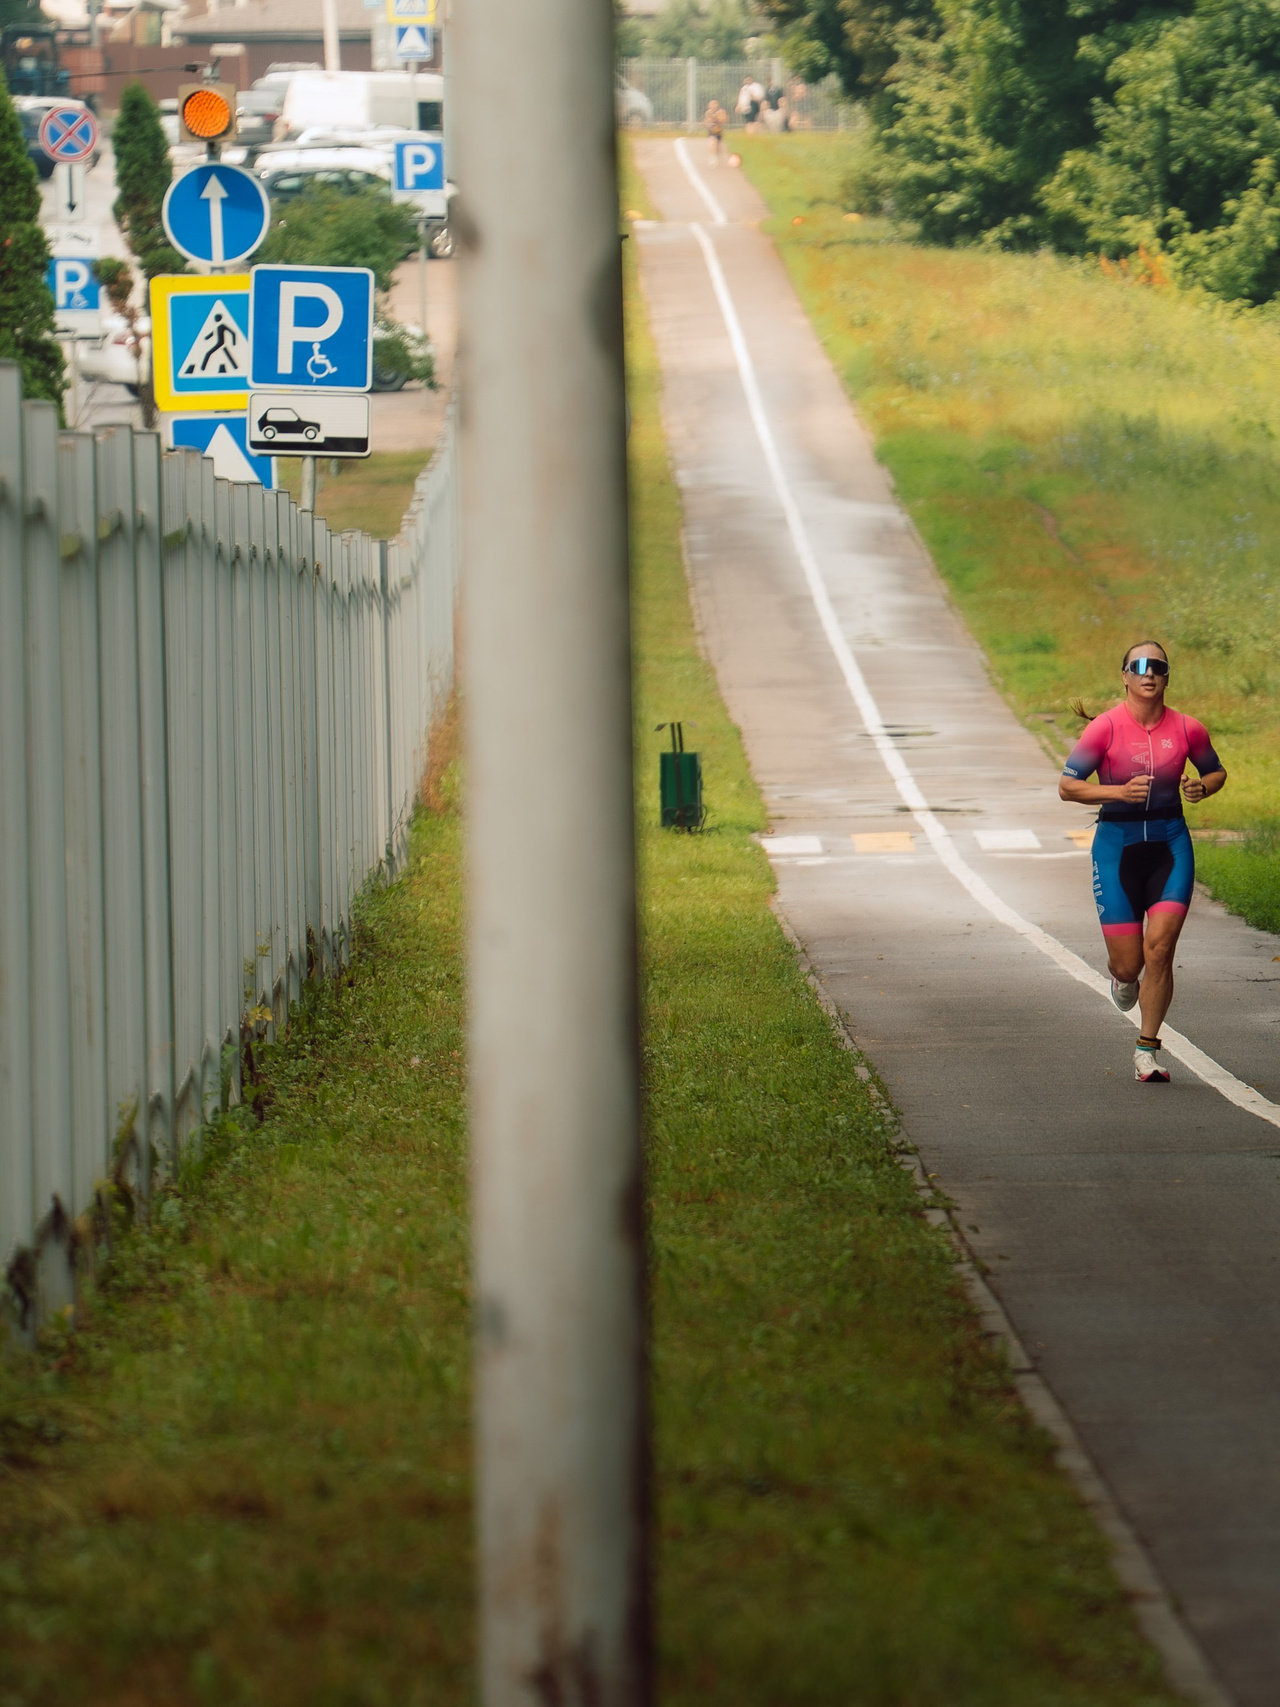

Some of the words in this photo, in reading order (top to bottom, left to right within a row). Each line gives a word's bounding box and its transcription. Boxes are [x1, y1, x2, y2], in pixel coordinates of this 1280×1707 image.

[403, 144, 436, 189] P
[55, 260, 90, 308] P
[276, 281, 344, 374] P
